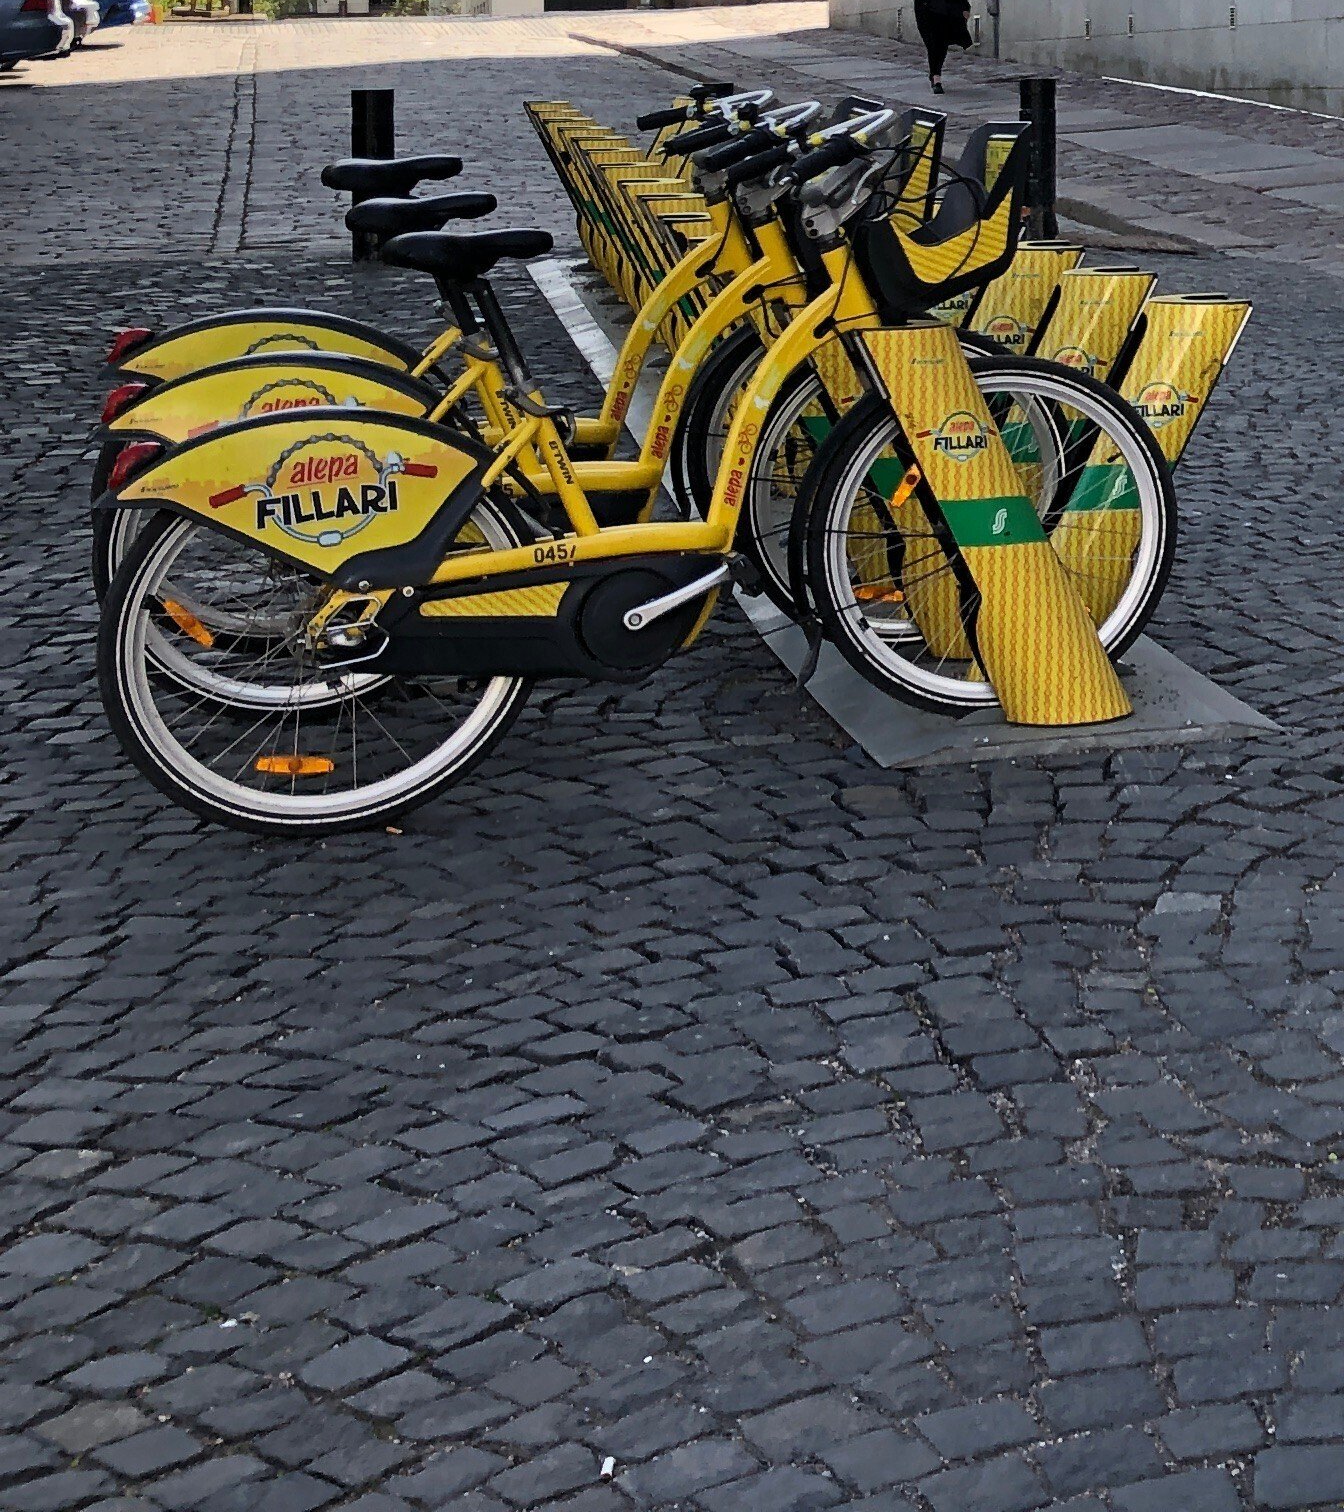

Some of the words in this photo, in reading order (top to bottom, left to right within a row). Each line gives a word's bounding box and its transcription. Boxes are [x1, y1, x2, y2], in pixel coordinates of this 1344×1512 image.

[934, 435, 988, 450] FILLARI
[289, 453, 359, 484] alepa
[724, 469, 743, 506] alepa
[256, 480, 399, 530] FILLARI
